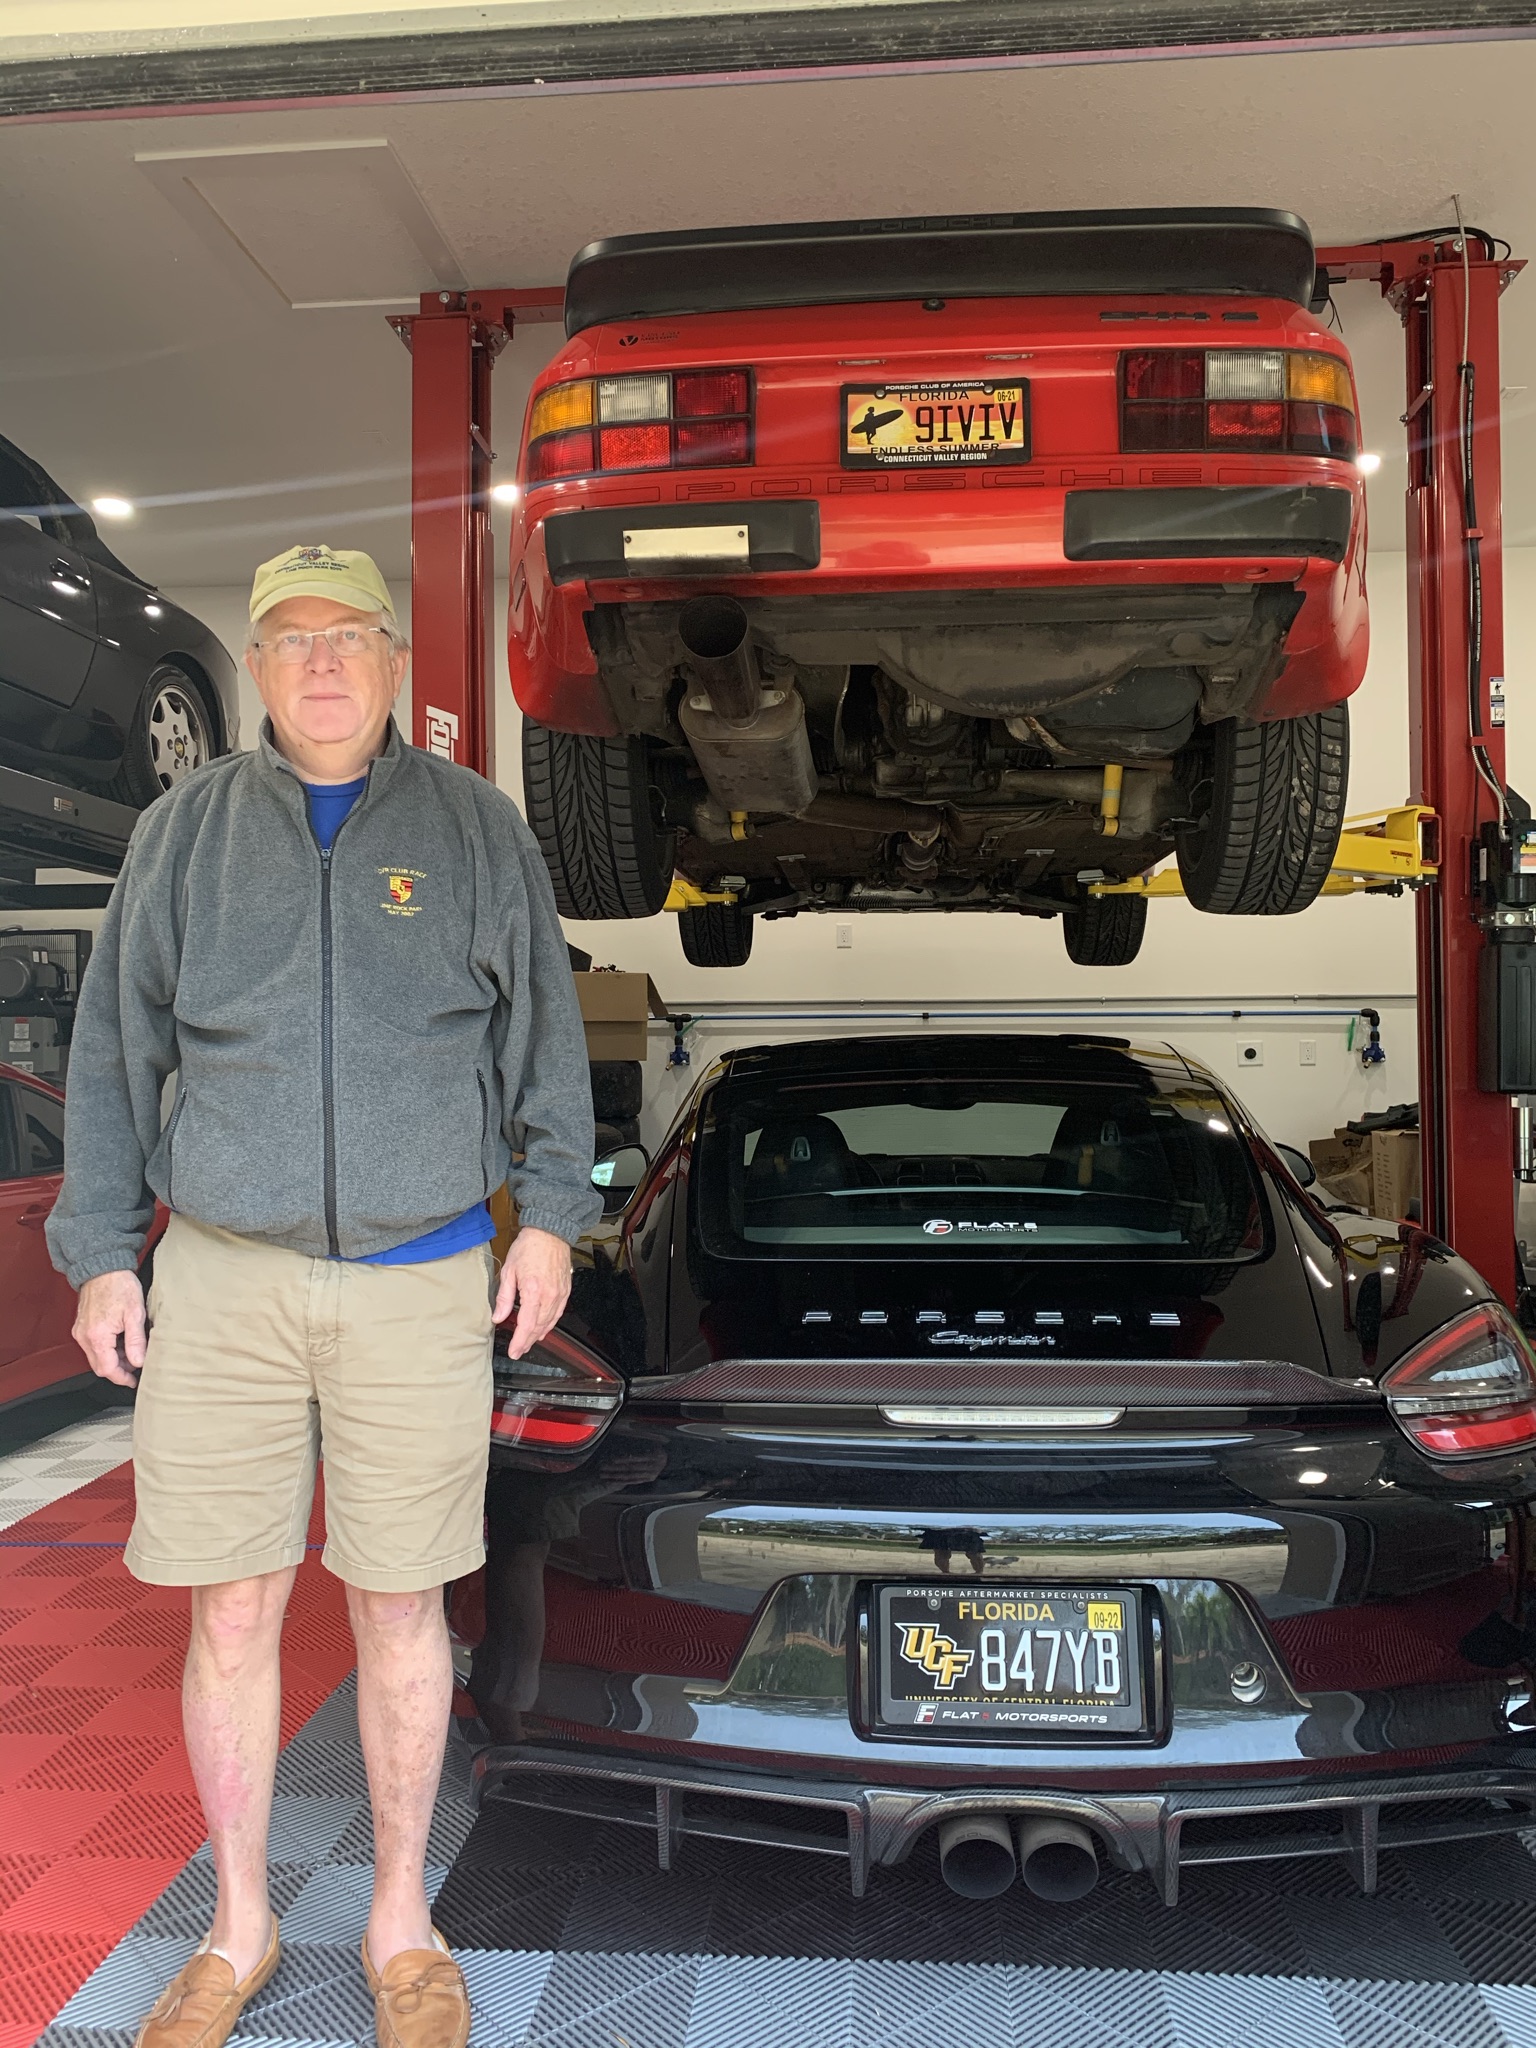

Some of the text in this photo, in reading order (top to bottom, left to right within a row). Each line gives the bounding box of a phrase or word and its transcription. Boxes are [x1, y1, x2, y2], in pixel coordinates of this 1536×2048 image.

[859, 216, 1014, 232] PORSCHE
[899, 391, 970, 402] FLORIDA
[997, 390, 1016, 402] 06-21
[915, 402, 1017, 443] 9IVIV
[870, 443, 1002, 454] ENDLESS SUMMER
[883, 452, 988, 463] CONNECTICUT VALLEY REGION
[676, 468, 1202, 500] PORSCHE
[410, 870, 427, 879] RACE
[958, 1221, 1020, 1229] FLAT
[802, 1311, 1181, 1327] PORSCHE
[928, 1330, 1056, 1352] Cayman
[906, 1589, 1109, 1600] PORSCHE AFTERMARKET SPECIALISTS
[958, 1601, 1055, 1622] FLORIDA
[1093, 1611, 1119, 1629] 09-22
[895, 1622, 975, 1690] UCF
[980, 1629, 1121, 1694] 847YB
[942, 1711, 980, 1720] FLAT
[995, 1712, 1108, 1724] MOTORSPORTS
